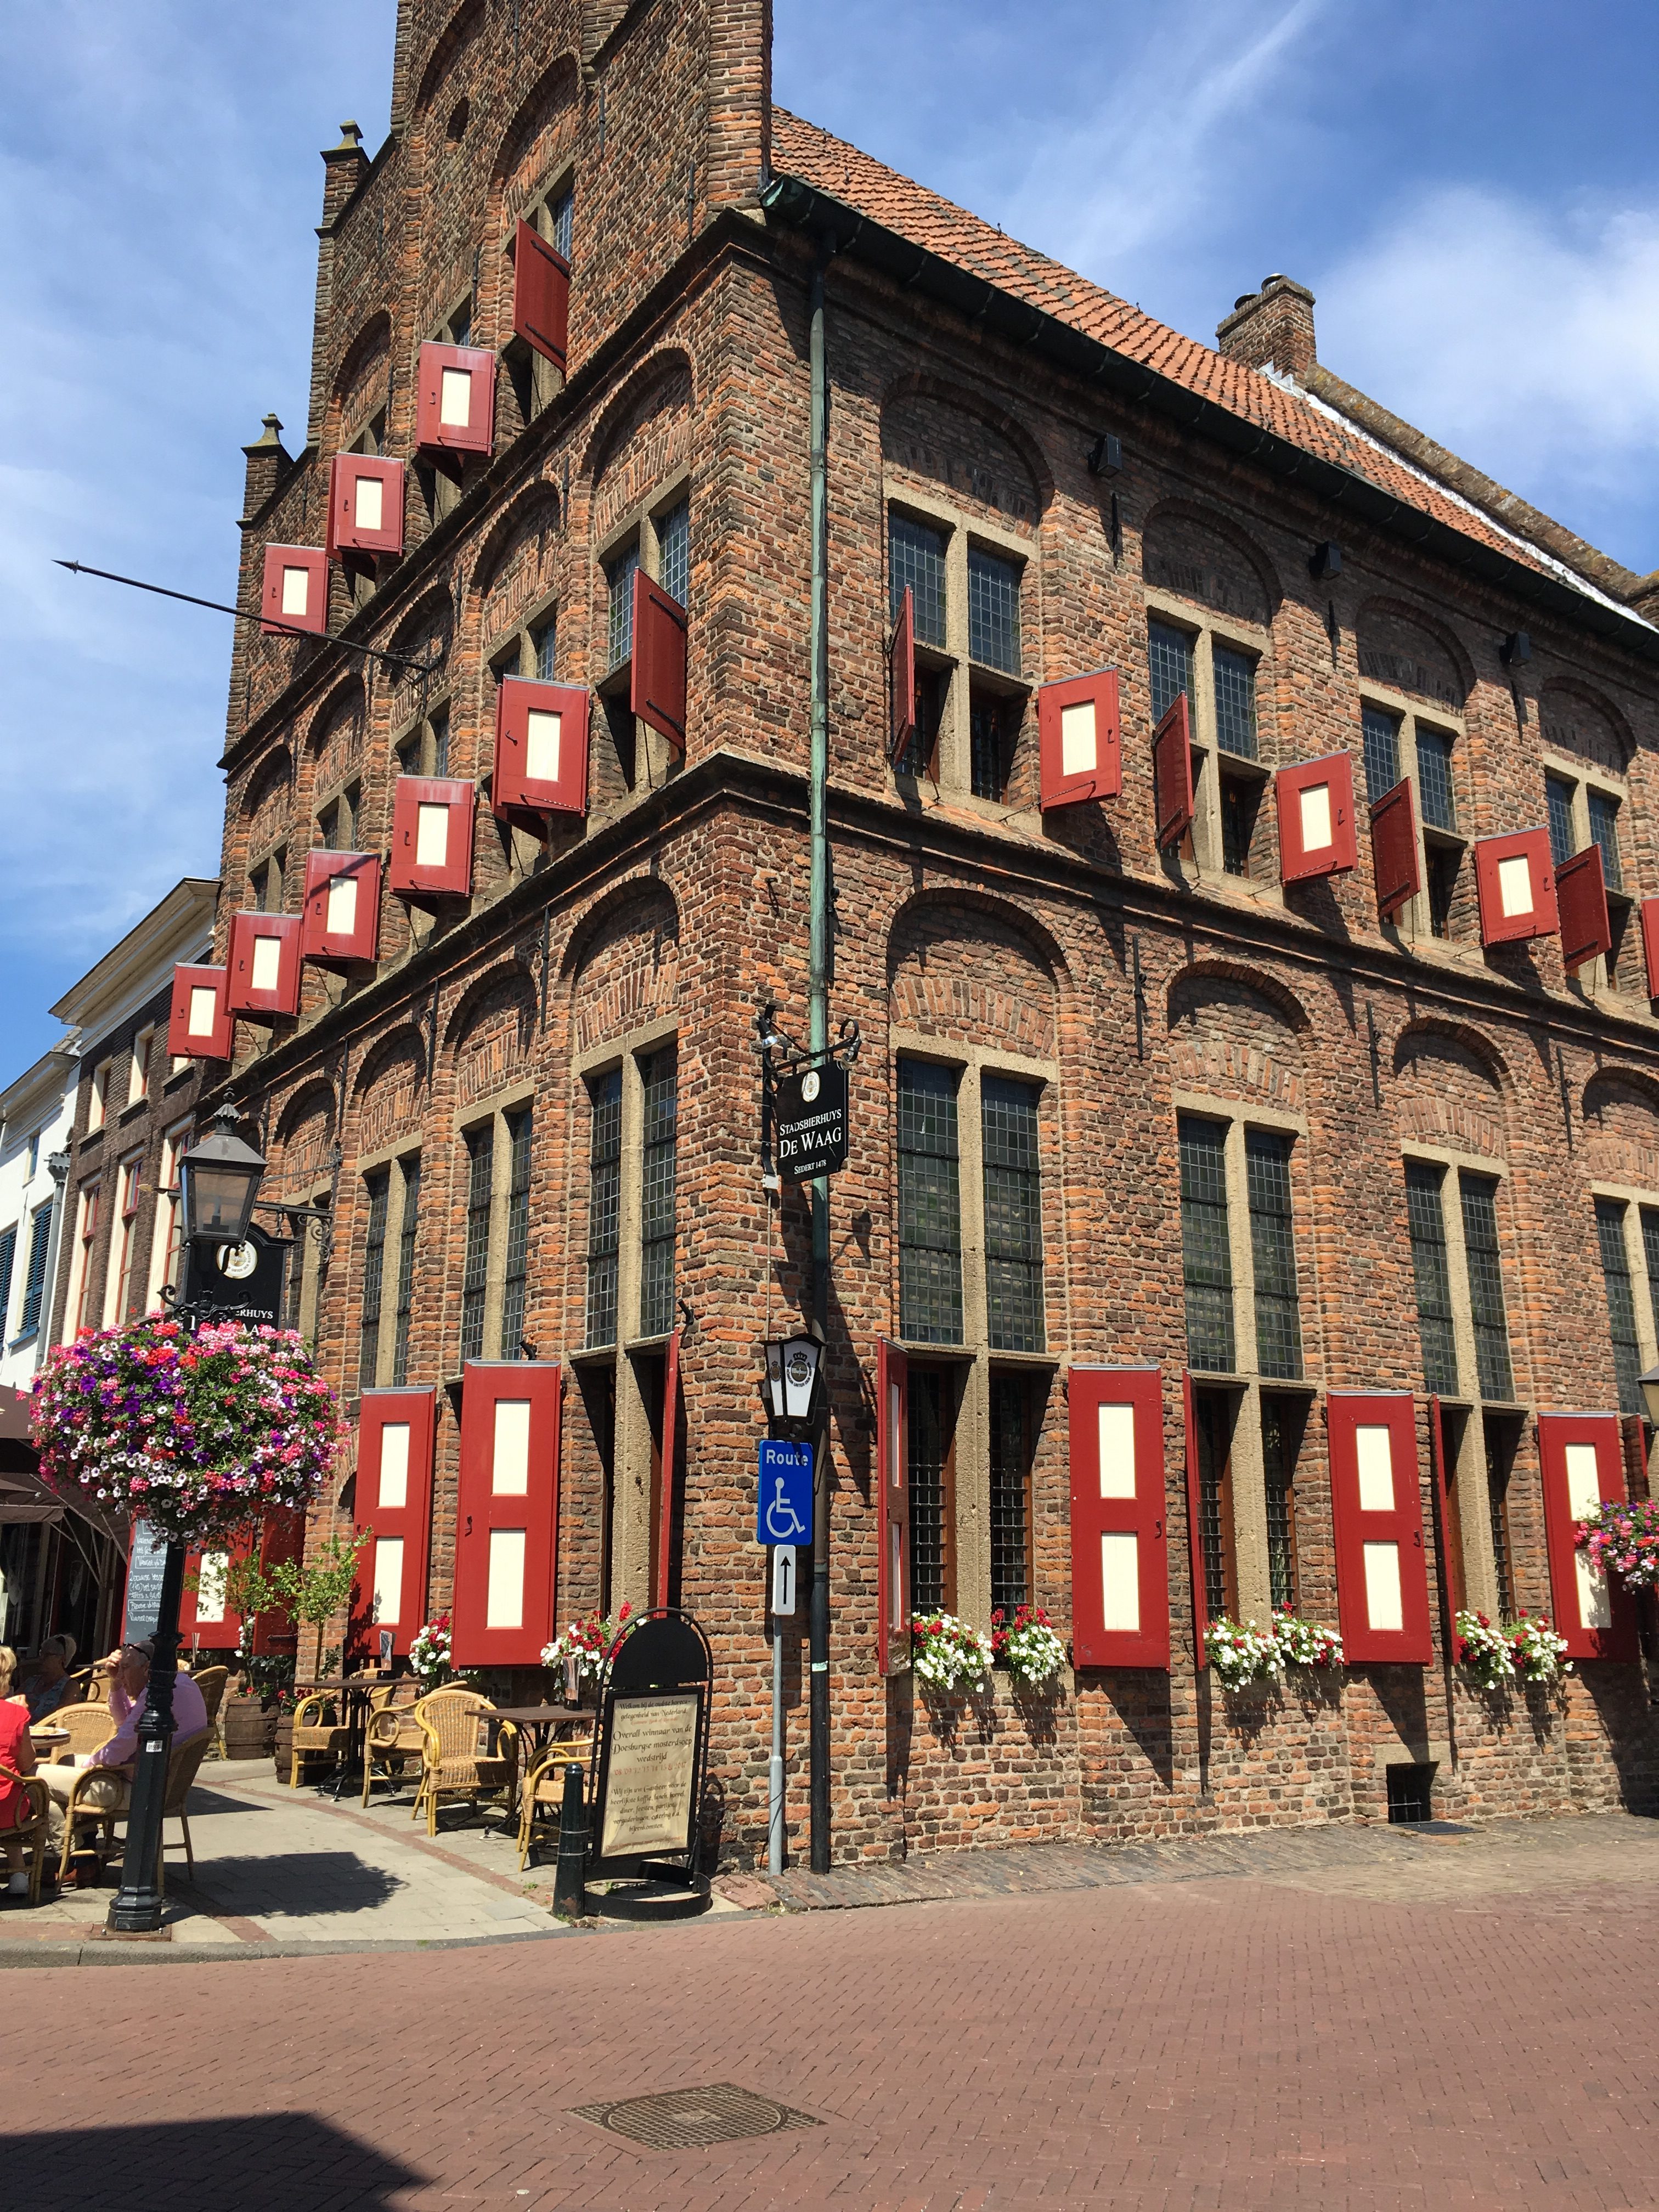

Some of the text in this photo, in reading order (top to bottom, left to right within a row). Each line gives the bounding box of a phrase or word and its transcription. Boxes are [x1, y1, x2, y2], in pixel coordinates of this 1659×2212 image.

[816, 1159, 827, 1169] 1478
[766, 1449, 809, 1466] Route
[613, 1729, 640, 1741] Overall
[642, 1728, 670, 1737] winnaar
[685, 1724, 692, 1733] de
[611, 1738, 692, 1755] Doesburgse mosterdsoep
[636, 1751, 668, 1764] wedstrijd
